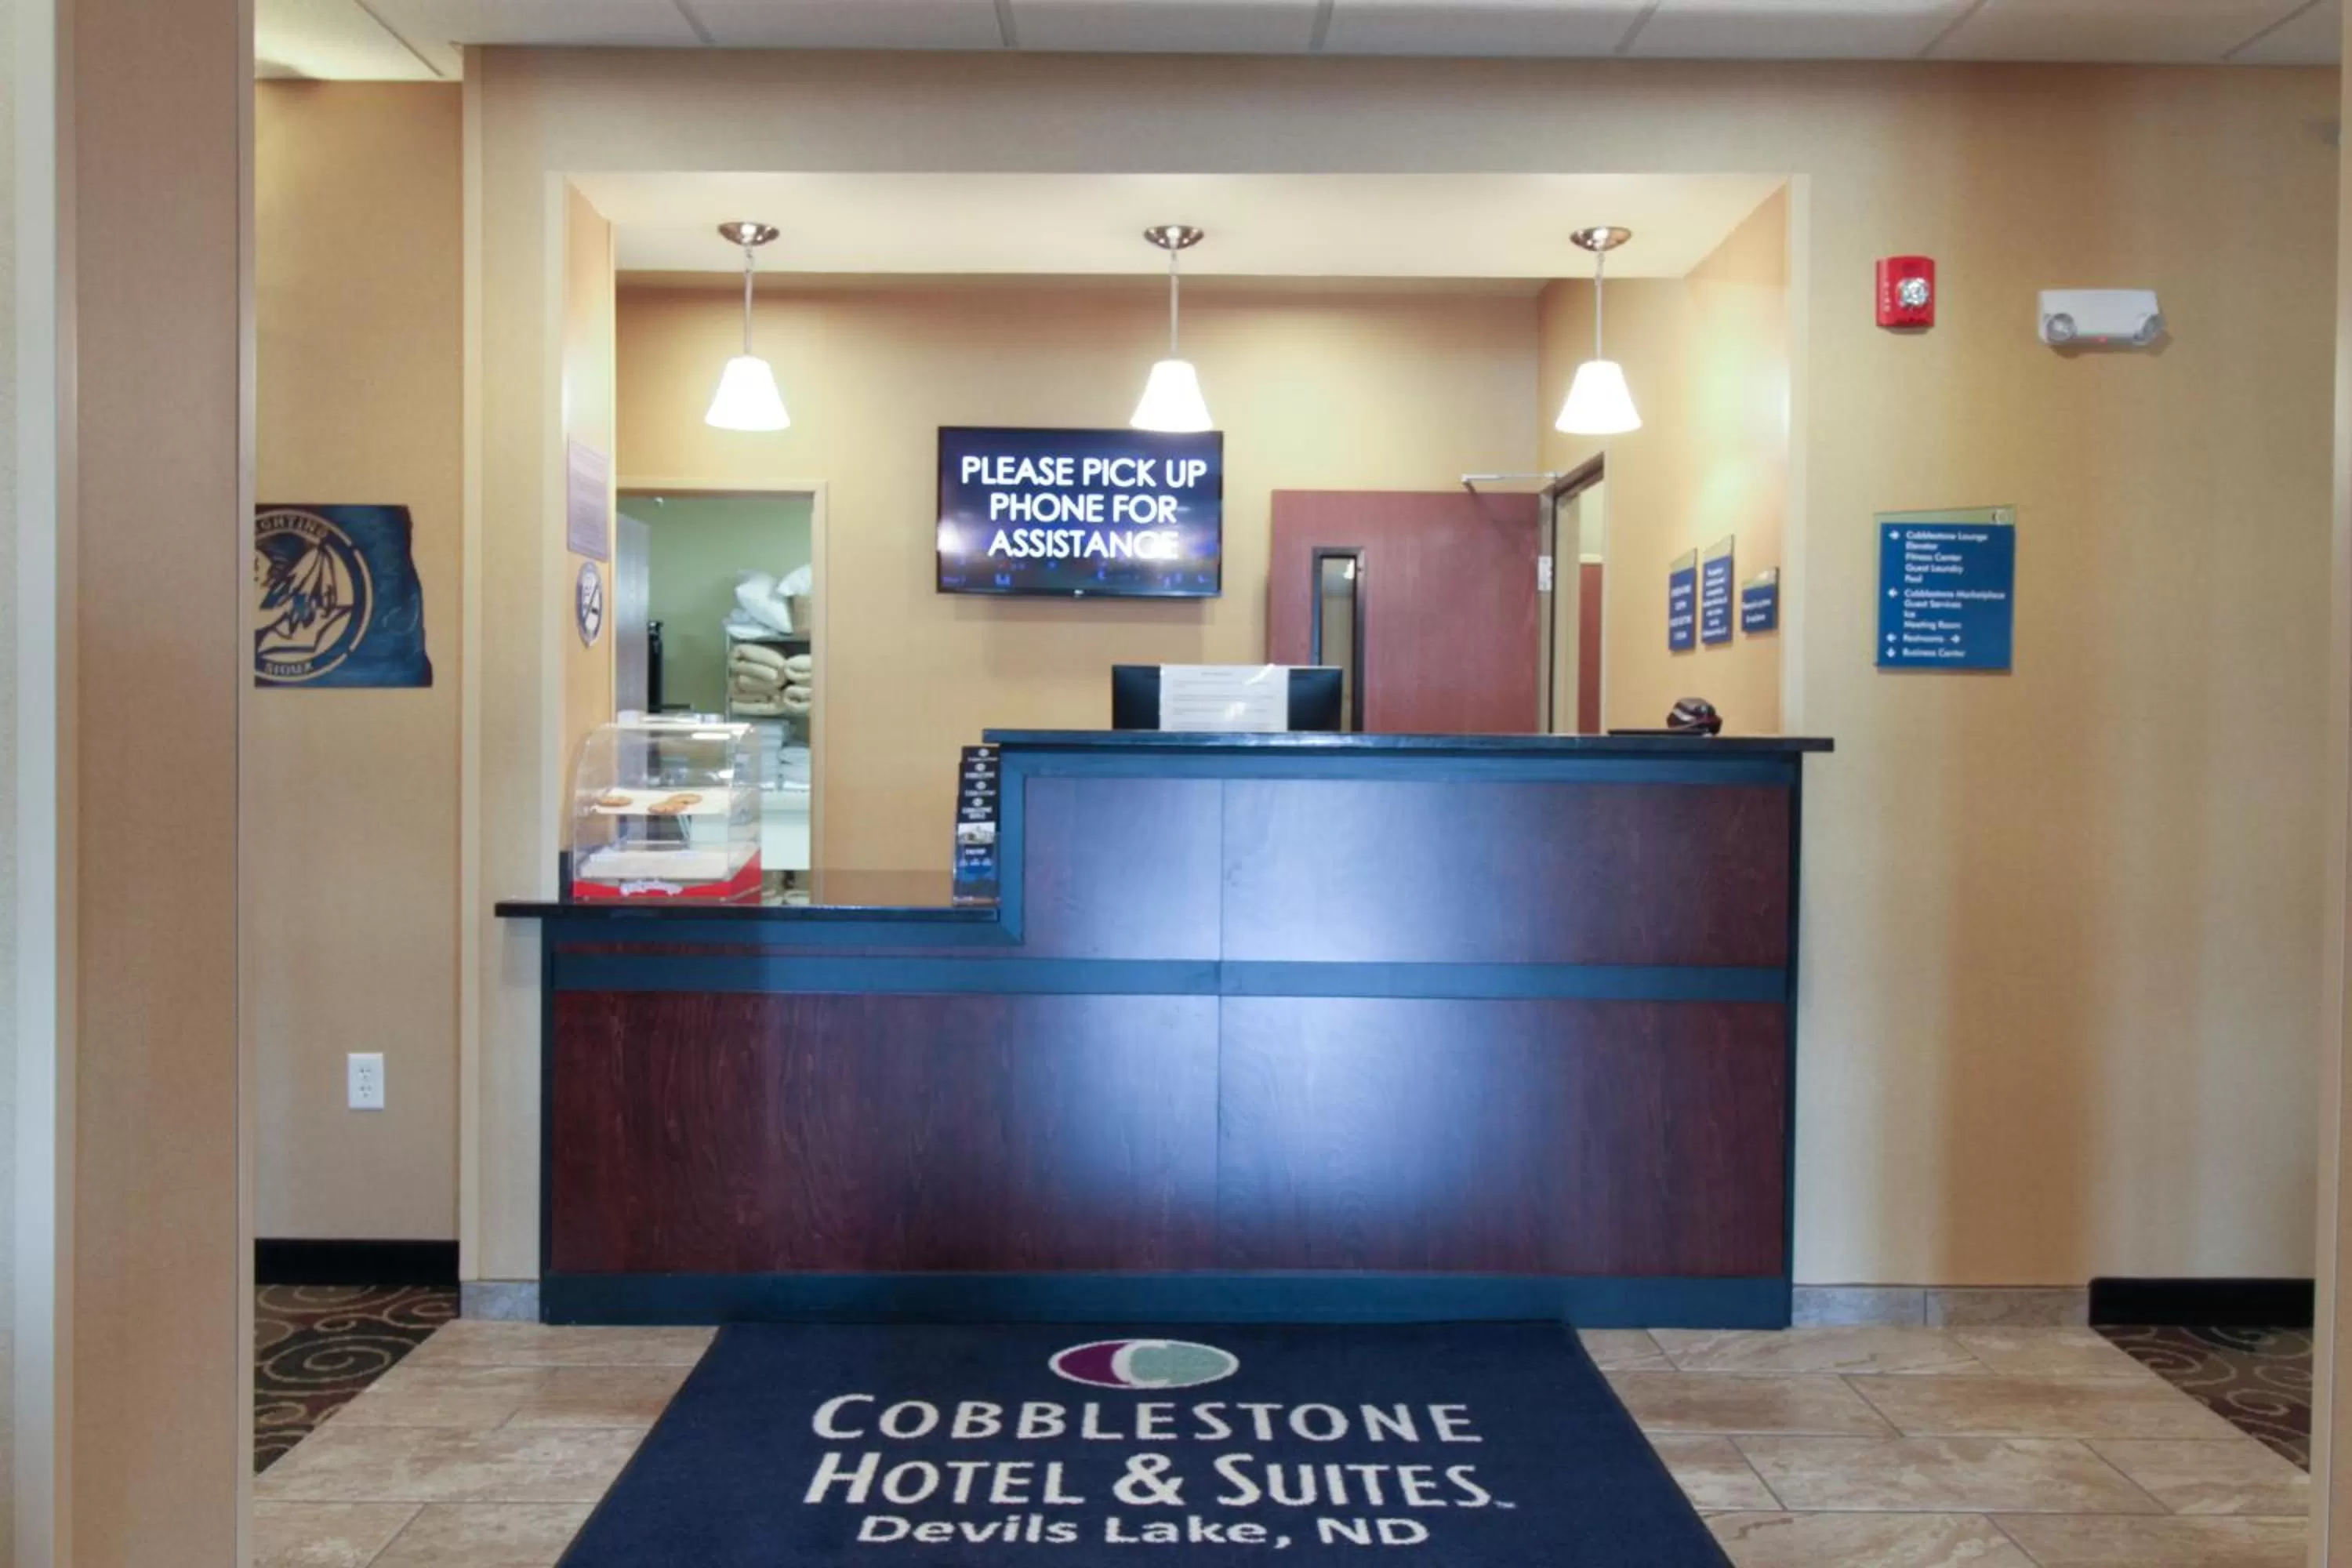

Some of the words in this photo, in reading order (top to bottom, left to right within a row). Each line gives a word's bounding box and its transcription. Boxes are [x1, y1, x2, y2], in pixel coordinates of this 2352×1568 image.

[962, 456, 1075, 486] PLEASE
[1082, 458, 1157, 487] PICK
[1165, 459, 1207, 488] UP
[989, 492, 1105, 523] PHONE
[1112, 494, 1178, 524] FOR
[987, 528, 1179, 560] ASSISTANCE
[811, 1393, 1483, 1443] COBBLESTONE
[804, 1452, 1086, 1505] HOTEL
[1112, 1453, 1185, 1506] &
[1214, 1454, 1494, 1508] SUITES
[857, 1514, 1079, 1544] Devils
[1104, 1515, 1291, 1549] Lake,
[1317, 1517, 1430, 1546] ND
